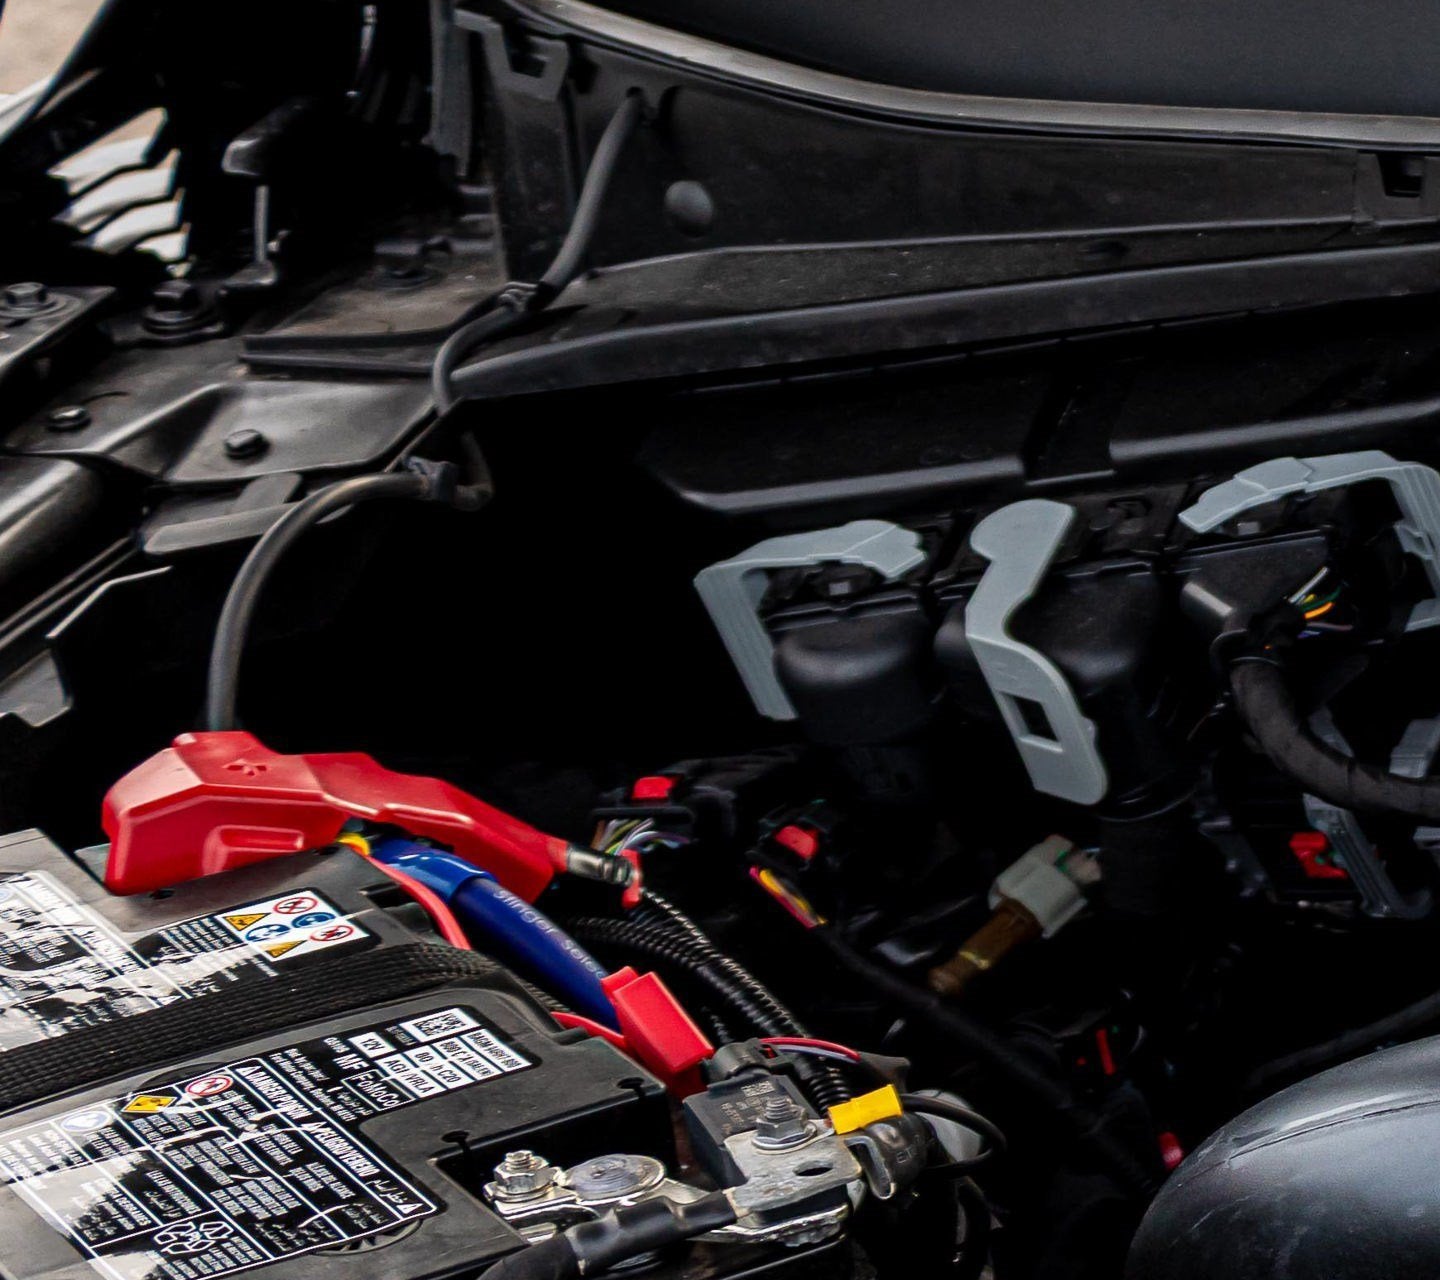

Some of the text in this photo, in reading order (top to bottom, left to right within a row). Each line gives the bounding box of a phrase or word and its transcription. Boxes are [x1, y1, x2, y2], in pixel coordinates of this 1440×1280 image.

[357, 1037, 385, 1052] 12V
[330, 1052, 370, 1072] MF
[347, 1072, 406, 1108] FoMoCo
